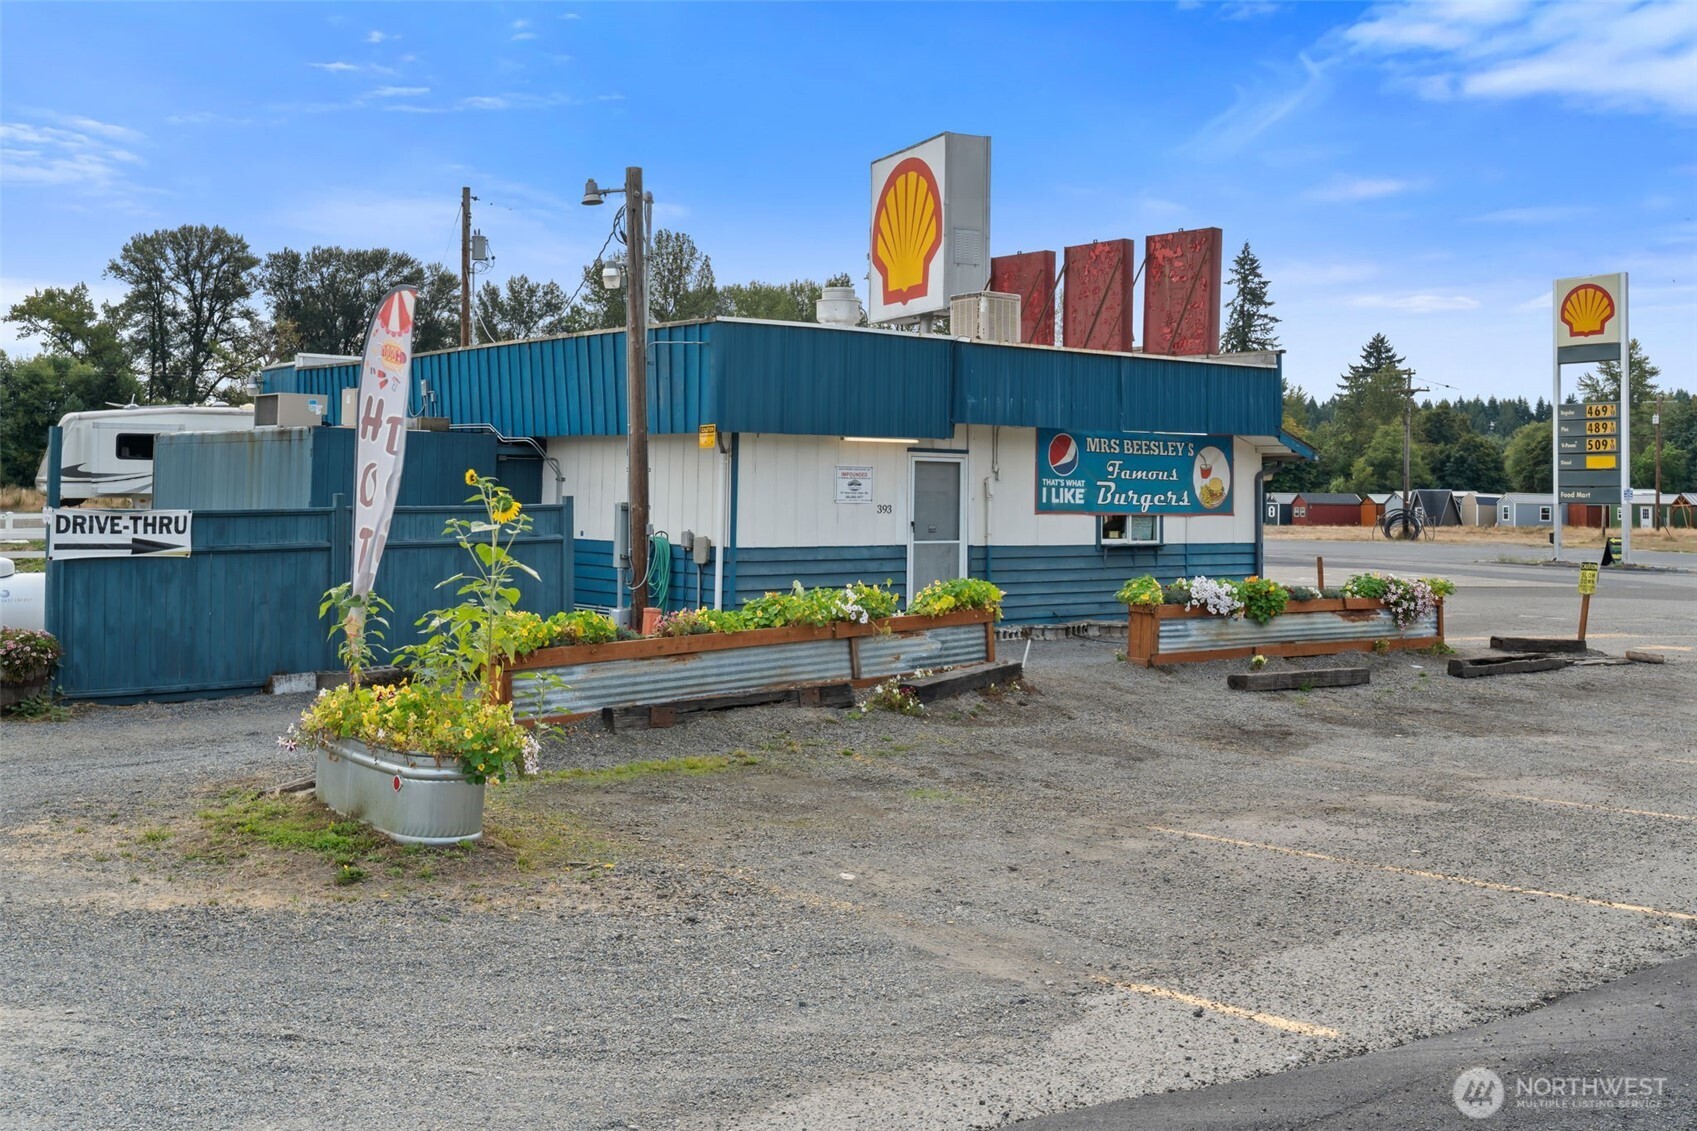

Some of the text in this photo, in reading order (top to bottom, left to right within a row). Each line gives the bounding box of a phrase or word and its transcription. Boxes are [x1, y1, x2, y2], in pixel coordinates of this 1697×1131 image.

[1587, 405, 1608, 416] 469
[1587, 422, 1608, 433] 489
[1086, 437, 1195, 457] MRS BEESLEY'S
[1587, 439, 1608, 450] 509
[1106, 460, 1179, 481] Famous
[1042, 478, 1086, 487] THAT'S WHAT
[1042, 487, 1085, 504] I LIKE
[1096, 481, 1191, 513] Burgers
[876, 504, 892, 514] 393
[55, 515, 188, 535] DRIVE-THRU
